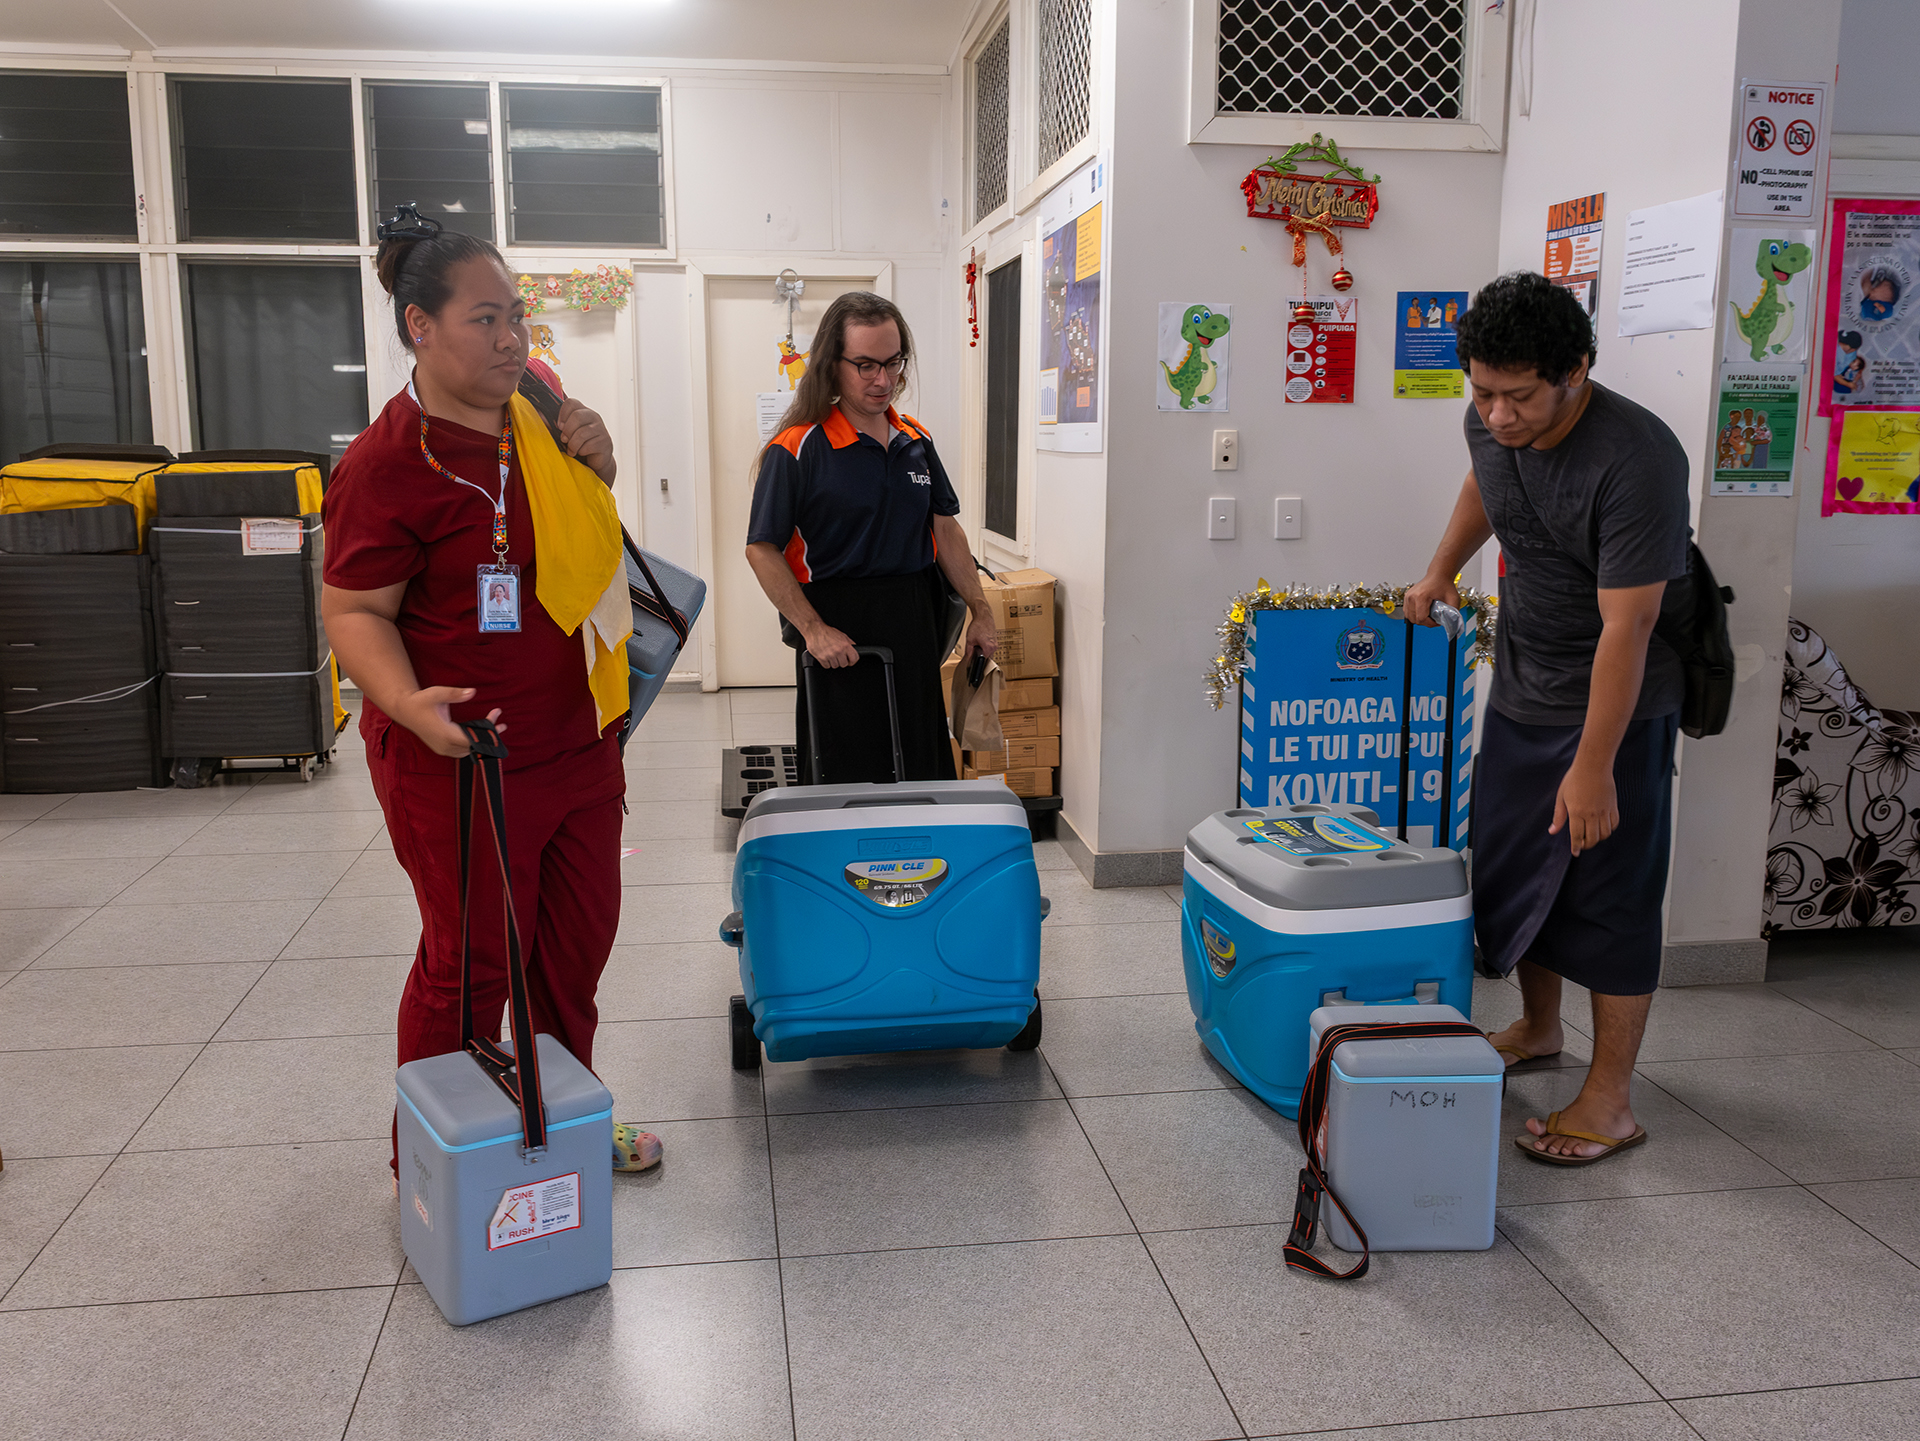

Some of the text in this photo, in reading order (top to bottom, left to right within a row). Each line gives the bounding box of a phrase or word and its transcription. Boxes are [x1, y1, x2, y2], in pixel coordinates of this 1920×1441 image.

[1768, 91, 1815, 105] NOTICE
[1740, 169, 1758, 184] NO
[1255, 176, 1368, 219] Merry Christmas
[1547, 192, 1604, 232] MISELA
[1270, 697, 1397, 727] NOFOAGA
[1269, 732, 1446, 763] LE TUI PUIPUI
[1268, 769, 1443, 807] KOVITI-19
[1389, 1089, 1456, 1108] MOH
[509, 1226, 535, 1239] RUSH
